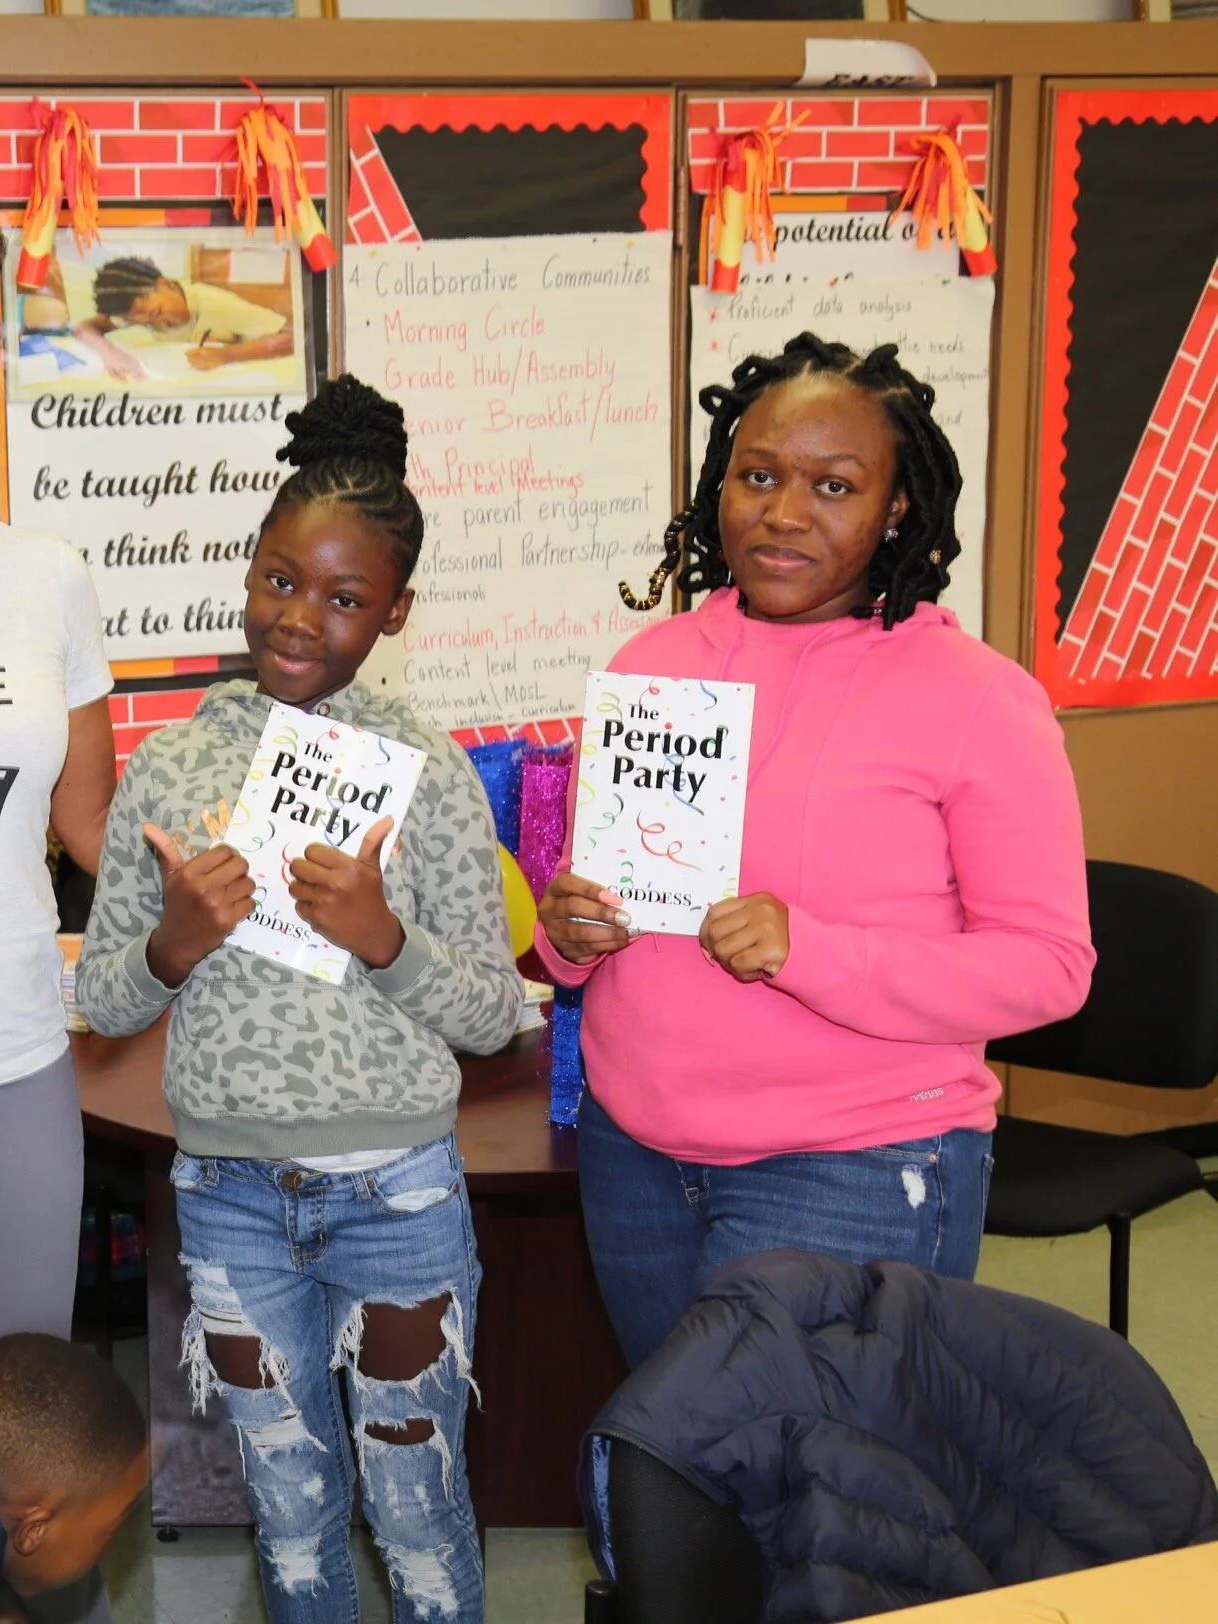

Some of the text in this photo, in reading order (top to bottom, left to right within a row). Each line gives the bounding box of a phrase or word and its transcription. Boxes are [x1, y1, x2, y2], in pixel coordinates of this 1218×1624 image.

[773, 216, 894, 251] potential
[376, 257, 519, 297] Collaborative
[542, 252, 651, 291] Communities
[384, 303, 547, 351] Morning Circle
[813, 296, 844, 318] data
[859, 295, 913, 322] analysis
[384, 355, 457, 391] Grade
[31, 390, 285, 430] Children must
[404, 415, 466, 437] enior
[33, 458, 282, 509] be taught how
[445, 444, 535, 489] Principal
[464, 490, 523, 538] parent
[538, 480, 654, 532] engagement
[104, 528, 192, 568] think
[203, 532, 256, 563] not
[413, 538, 503, 578] rofessional
[101, 596, 245, 637] at to thin
[503, 611, 587, 645] Instruction
[403, 647, 592, 685] Content level meeting
[628, 703, 659, 721] The
[305, 741, 333, 763] The
[602, 718, 728, 759] Period
[270, 750, 393, 814] Period
[612, 754, 708, 803] Party
[270, 786, 360, 847] Party
[247, 911, 313, 942] ODDESS
[909, 1087, 945, 1103] adidas
